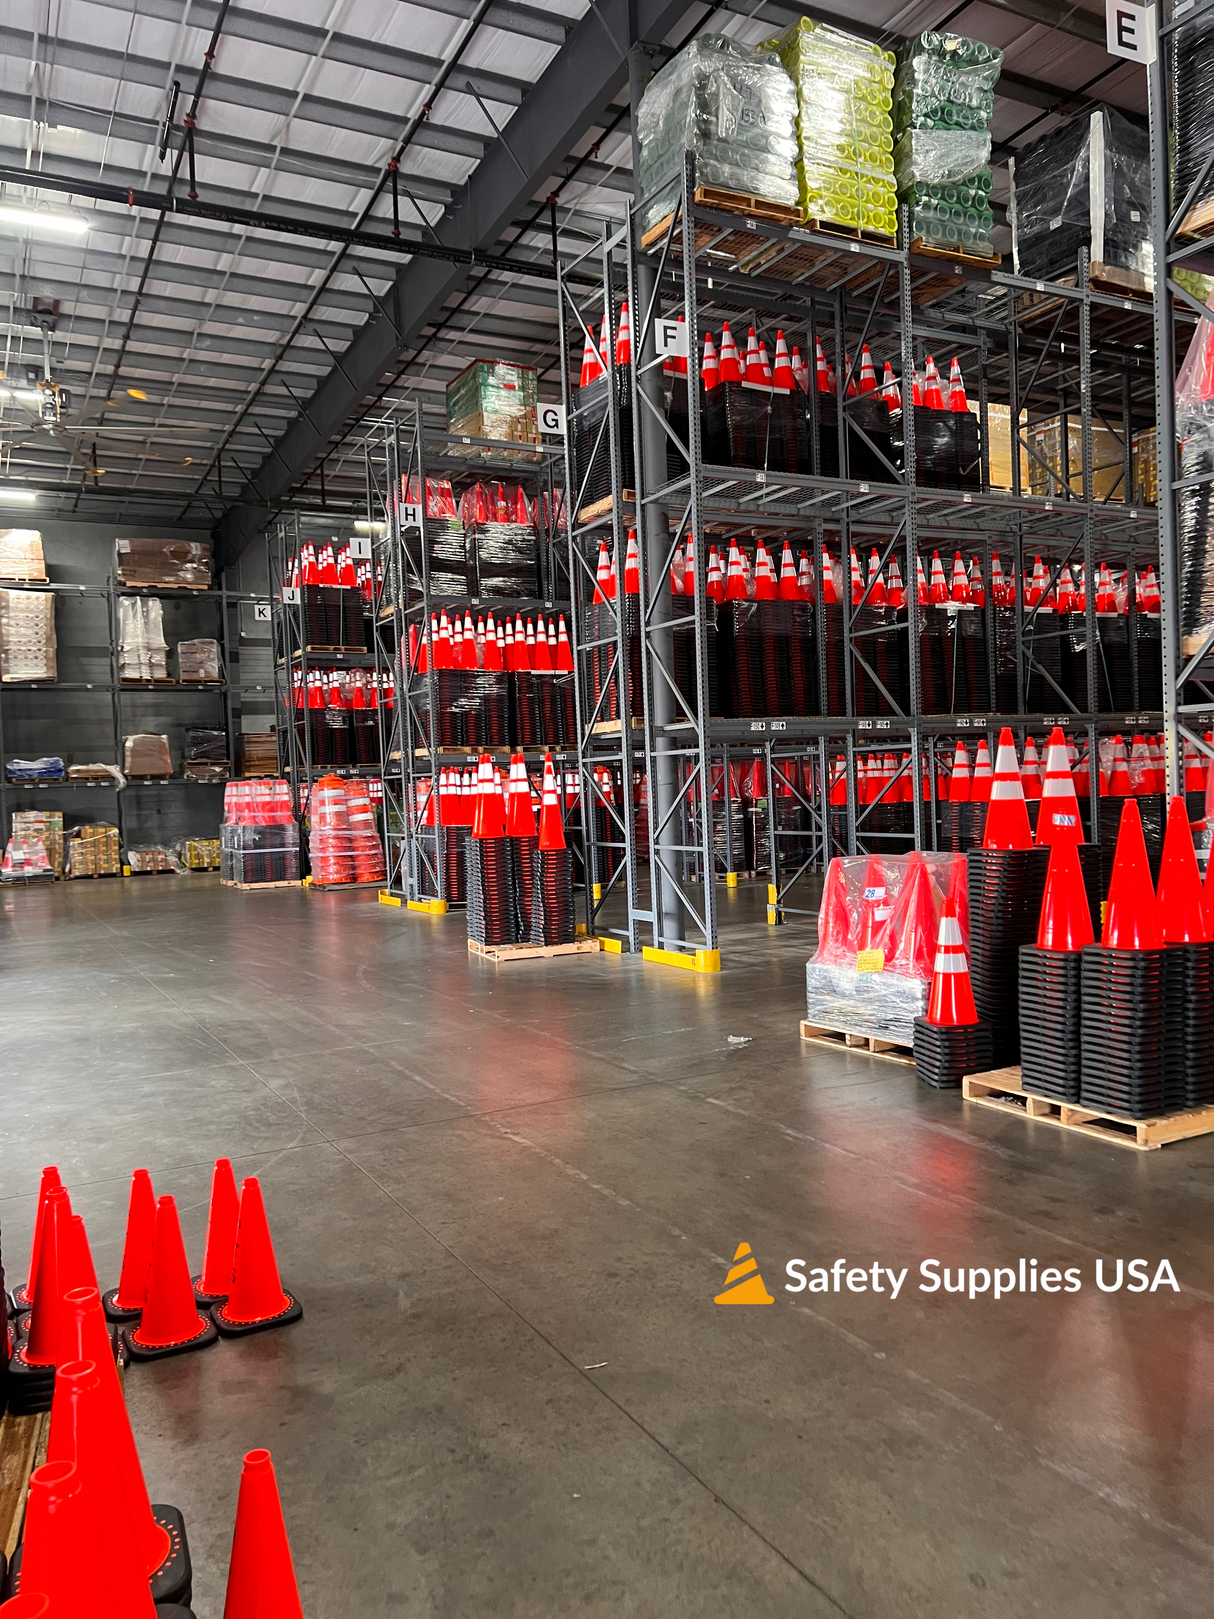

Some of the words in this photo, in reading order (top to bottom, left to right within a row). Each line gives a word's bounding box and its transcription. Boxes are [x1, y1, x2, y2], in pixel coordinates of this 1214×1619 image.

[1116, 10, 1138, 51] E
[664, 326, 677, 348] F
[543, 409, 559, 430] G
[405, 507, 417, 522] H
[288, 590, 295, 601] J
[258, 607, 267, 618] K
[865, 889, 875, 898] 28
